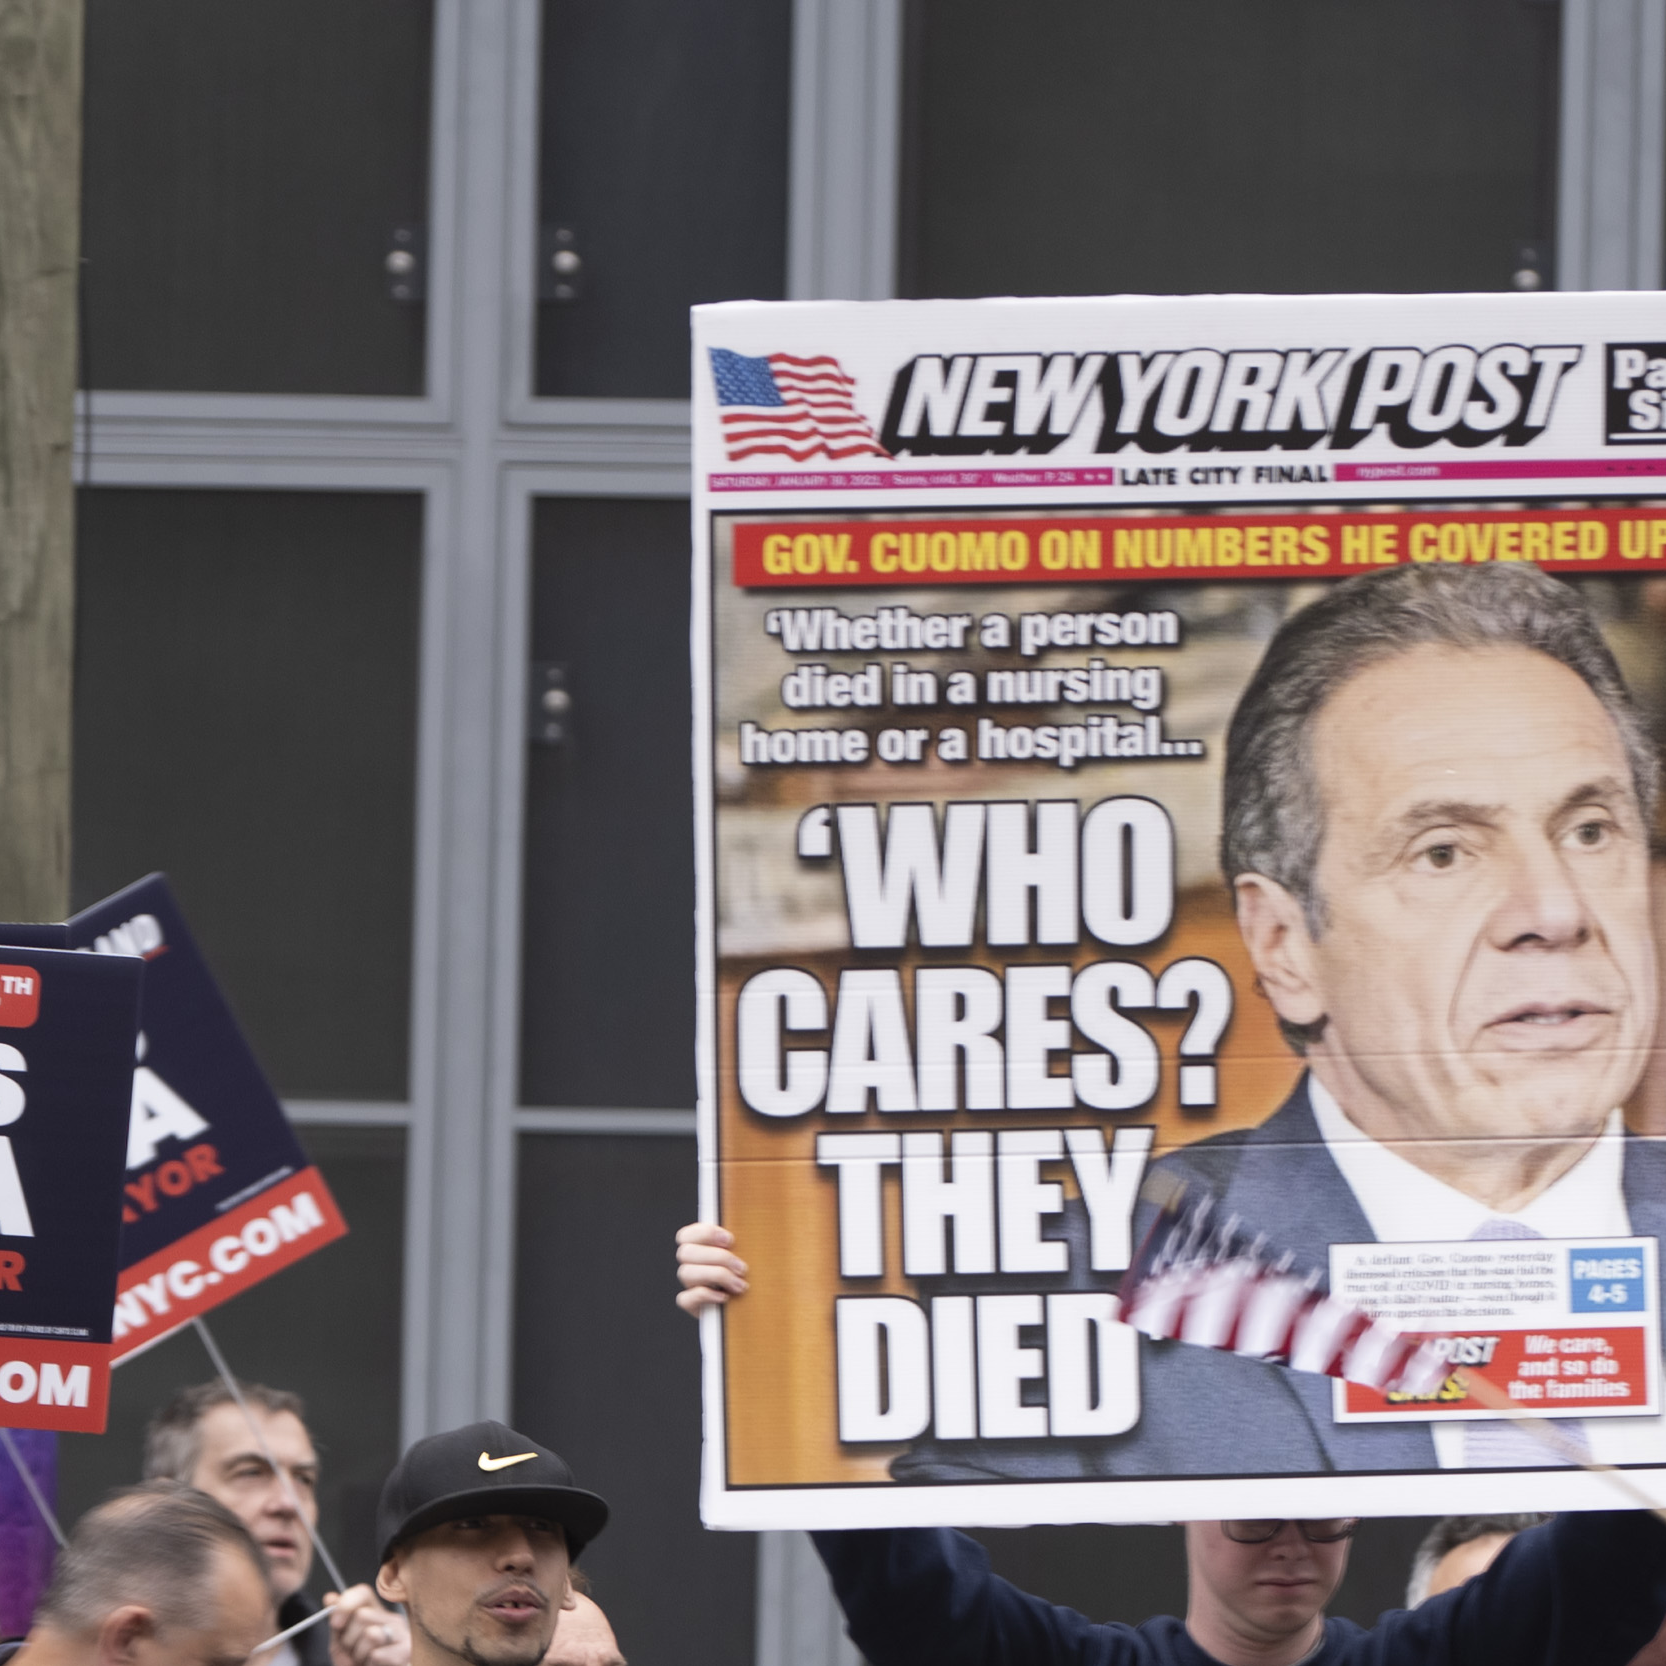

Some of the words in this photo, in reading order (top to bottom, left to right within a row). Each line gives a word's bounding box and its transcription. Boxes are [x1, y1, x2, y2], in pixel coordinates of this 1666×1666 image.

[878, 352, 1115, 456] NEW
[1095, 348, 1351, 455] YORK
[1329, 344, 1584, 449] POST
[1121, 466, 1184, 487] LATE
[1190, 464, 1246, 486] CITY
[1254, 463, 1330, 485] FINAL
[762, 528, 860, 574] GOV.
[869, 526, 1027, 572] CUOMO
[1036, 526, 1104, 568] ON
[1113, 520, 1330, 568] NUMBERS
[1340, 519, 1398, 564] HE
[1408, 515, 1608, 562] COVERED
[1019, 609, 1180, 658] person
[782, 664, 885, 711] died
[986, 666, 1161, 716] nursing
[740, 720, 869, 766] home
[977, 713, 1206, 763] hospital...
[735, 956, 1235, 1119] CARES?
[816, 1124, 1157, 1280] THEY
[1572, 1258, 1642, 1280] PAGES
[1587, 1283, 1628, 1304] 4-5
[1517, 1358, 1559, 1377] and
[1561, 1361, 1587, 1376] so
[1590, 1357, 1619, 1375] do
[1524, 1335, 1556, 1354] We
[1557, 1336, 1614, 1357] care,
[1508, 1379, 1544, 1399] the
[1545, 1378, 1631, 1399] families
